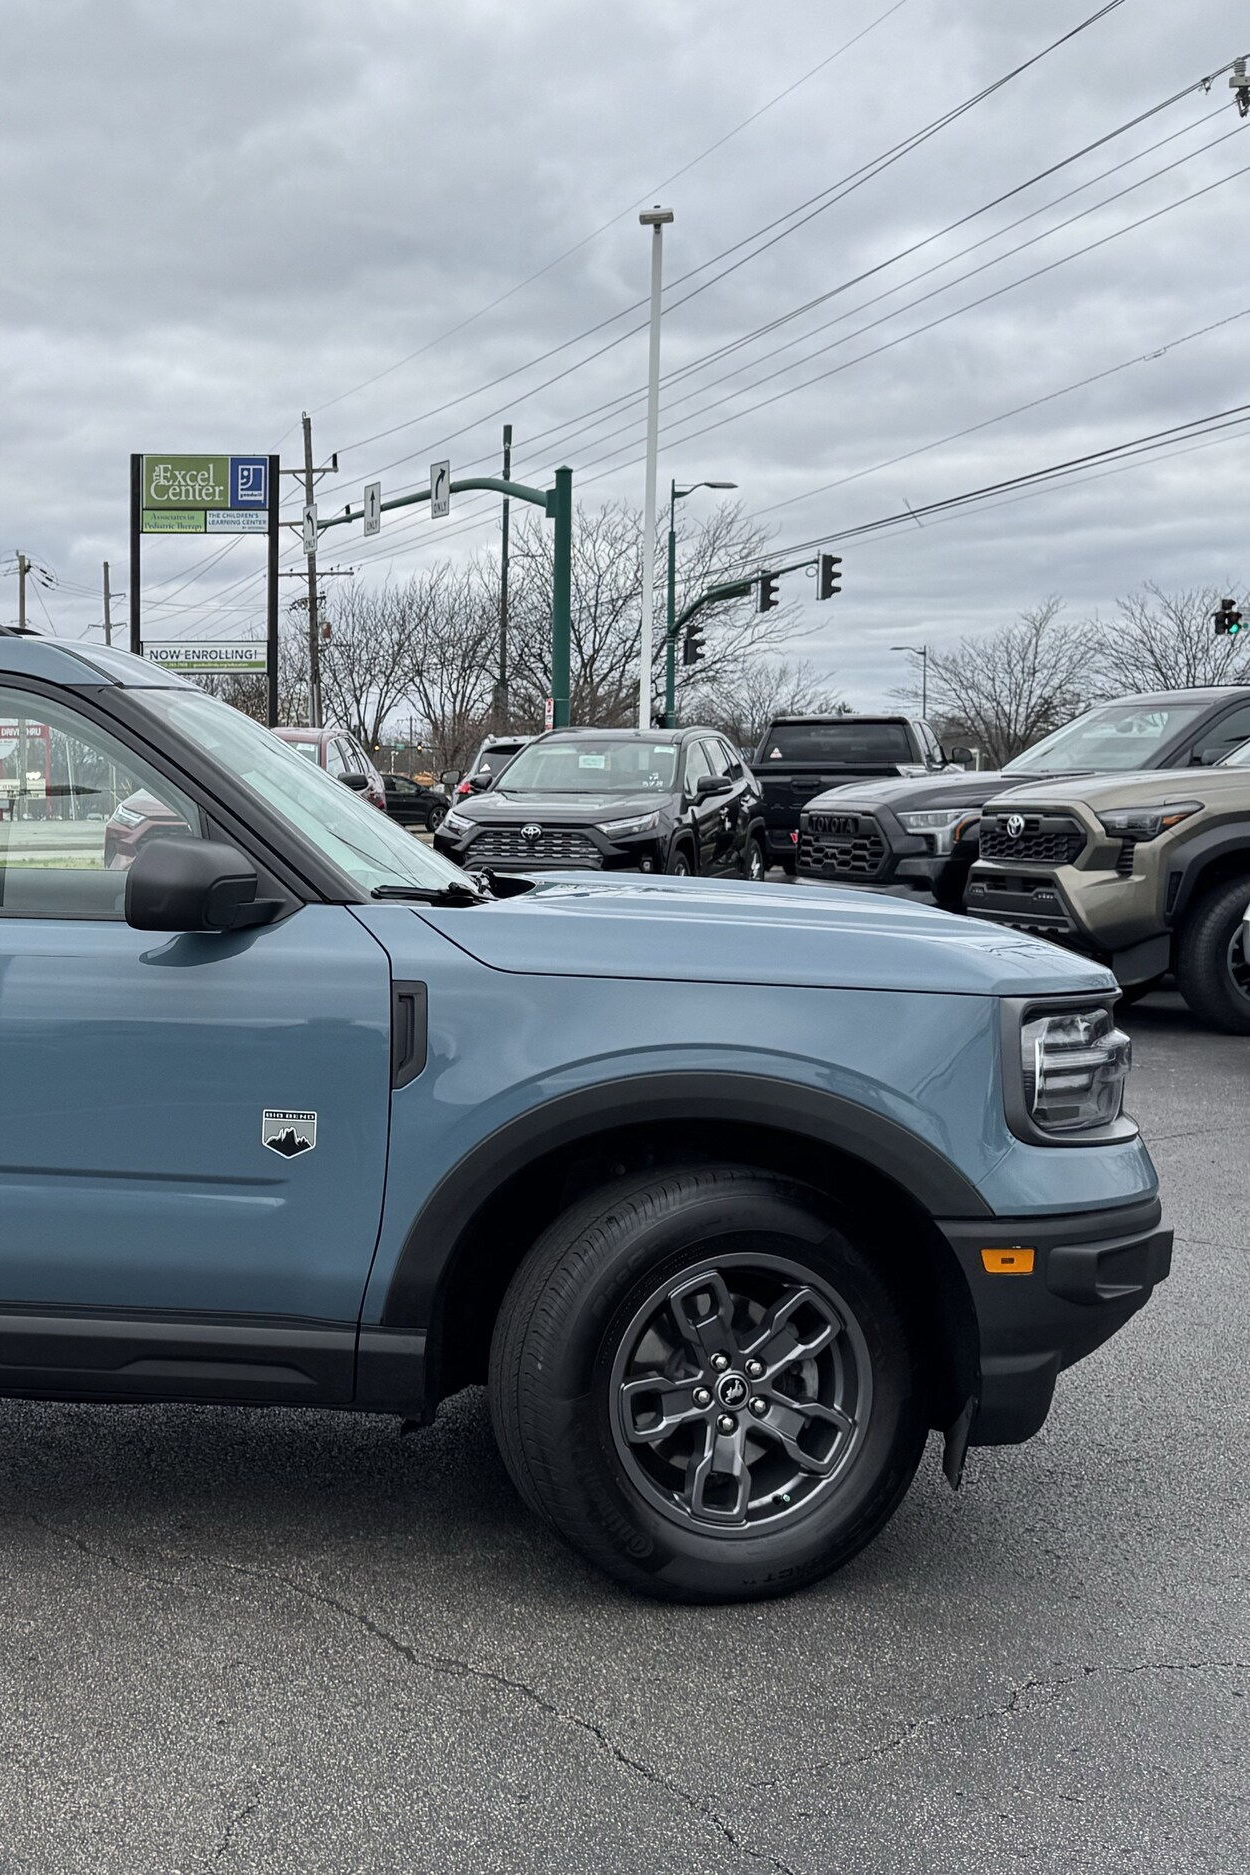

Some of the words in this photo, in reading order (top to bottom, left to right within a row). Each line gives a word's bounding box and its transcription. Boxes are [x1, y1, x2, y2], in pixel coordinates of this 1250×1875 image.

[158, 464, 215, 486] Excel
[150, 480, 224, 501] Center
[433, 501, 447, 514] ONLY
[366, 520, 378, 532] ONLY
[150, 650, 180, 660] NOW
[184, 649, 258, 660] ENROLLING!
[26, 728, 41, 736] HRU
[811, 816, 855, 833] TOYOTA
